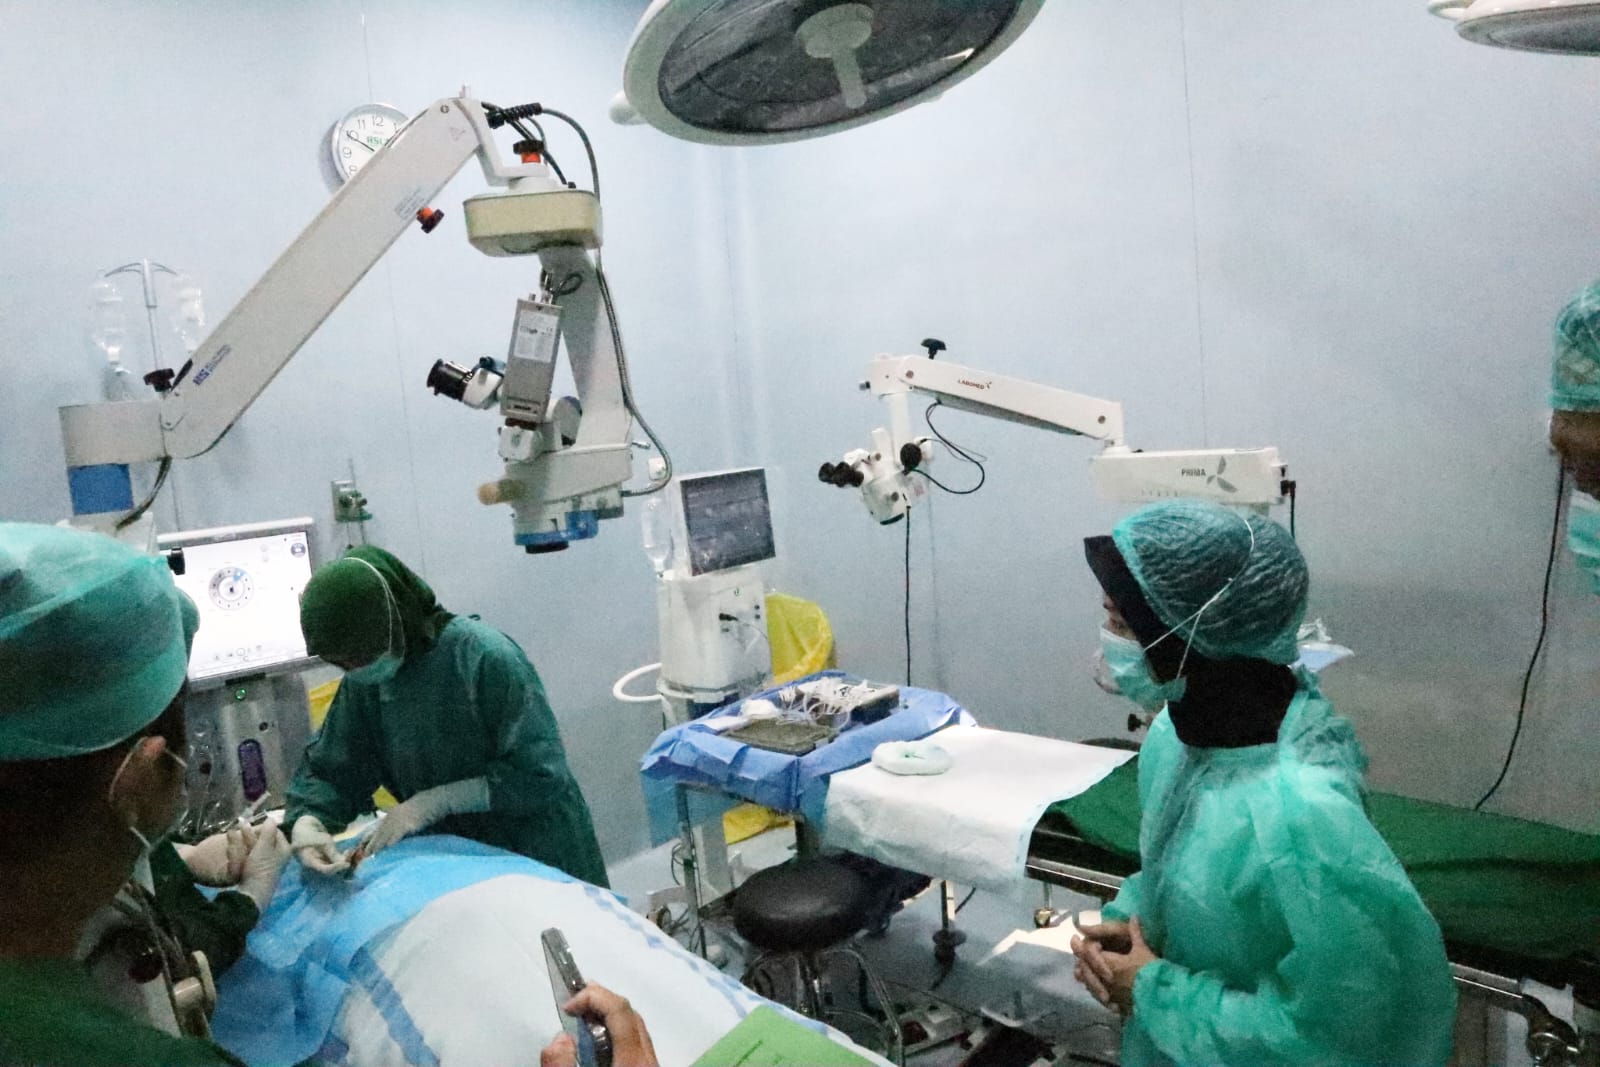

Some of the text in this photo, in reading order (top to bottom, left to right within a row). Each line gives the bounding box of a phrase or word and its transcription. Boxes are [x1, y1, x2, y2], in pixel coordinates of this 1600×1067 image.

[357, 119, 365, 129] 11
[372, 115, 384, 126] 12
[343, 147, 352, 158] 9
[1181, 468, 1206, 477] PRIMA
